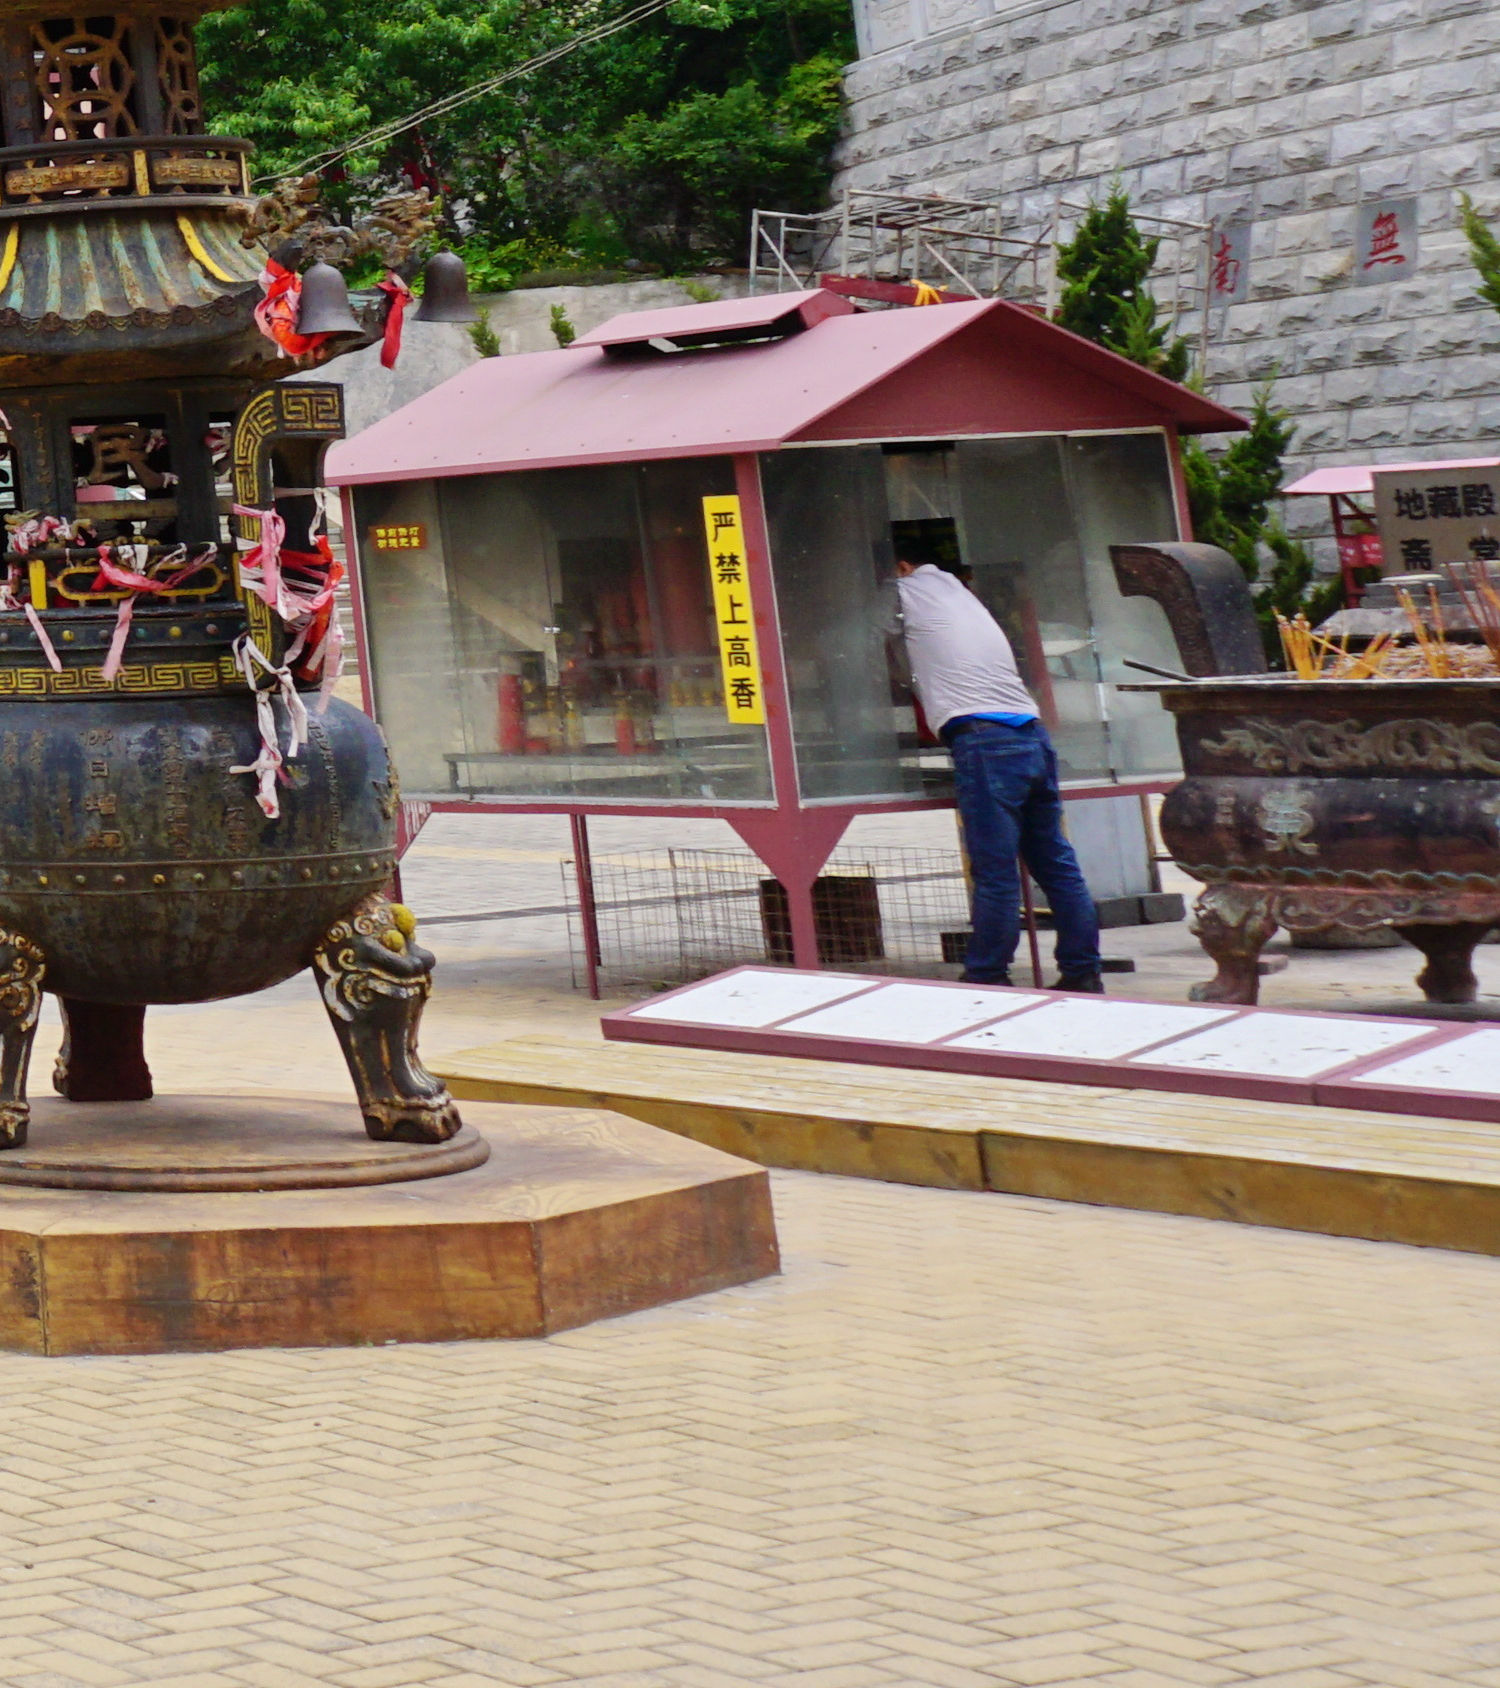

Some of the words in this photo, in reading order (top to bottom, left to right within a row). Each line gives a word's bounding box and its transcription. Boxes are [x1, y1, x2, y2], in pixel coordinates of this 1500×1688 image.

[1394, 483, 1497, 520] 地藏殿
[711, 512, 756, 710] 严禁上高香
